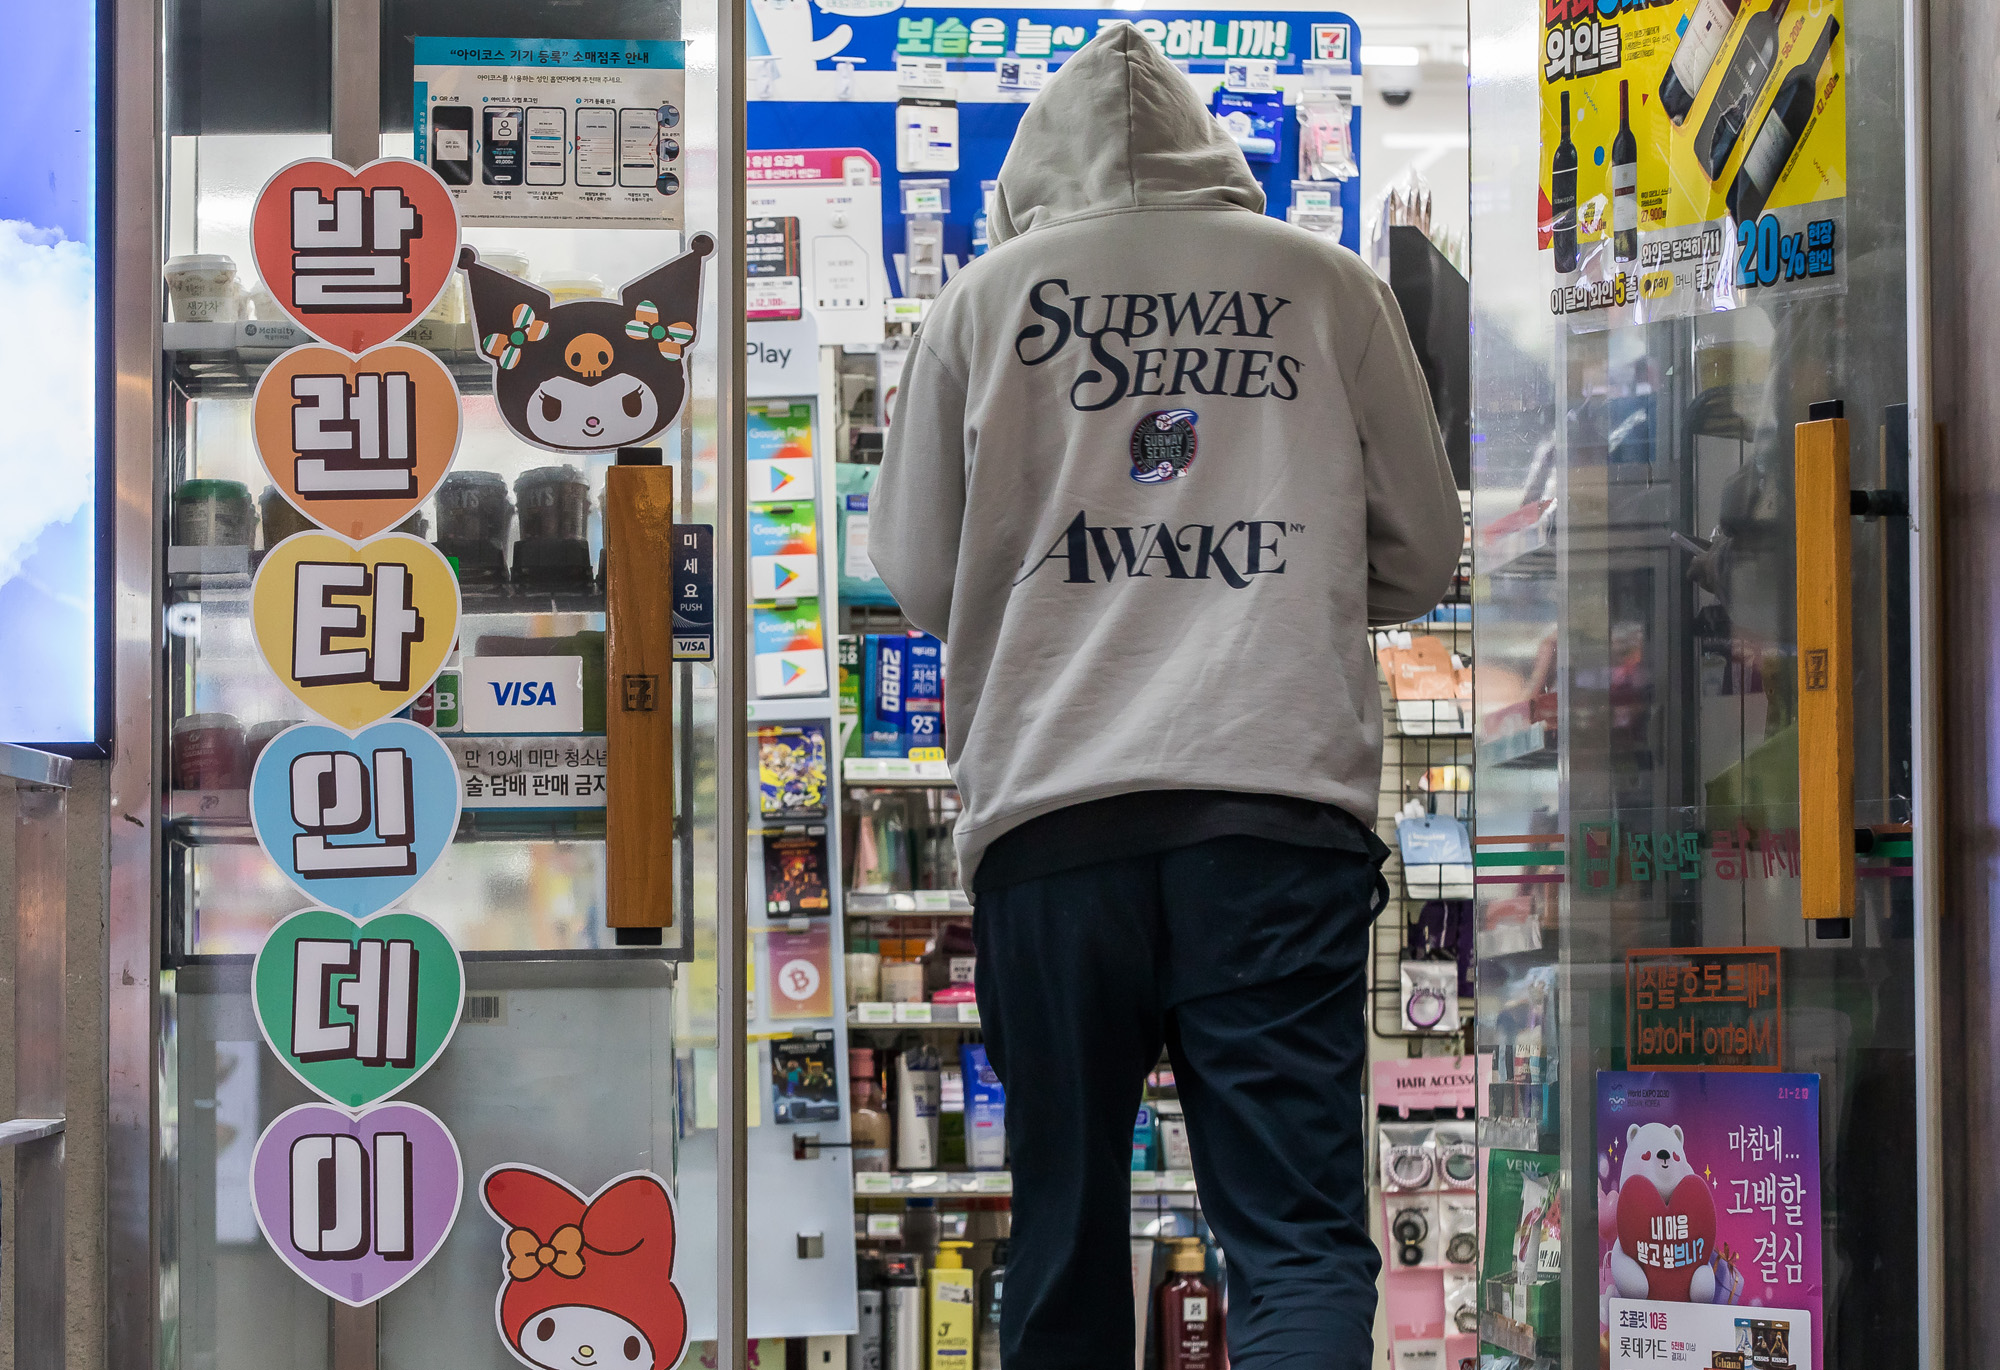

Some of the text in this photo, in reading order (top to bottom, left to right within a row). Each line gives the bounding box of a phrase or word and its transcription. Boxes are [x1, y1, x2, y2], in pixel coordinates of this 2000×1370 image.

[896, 17, 1288, 57] 보습은 늘~ 요하니까!
[450, 49, 649, 65] “아이코스 기기 등록” 소매점주 안내
[1545, 22, 1621, 82] 와인들
[477, 74, 508, 83] 아이코스를
[510, 75, 534, 83] 사용하는
[536, 75, 549, 83] 성인
[1807, 219, 1835, 248] 현장
[1641, 241, 1672, 267] 와인은
[1672, 237, 1702, 262] 당연히
[1737, 214, 1808, 289] 20%
[1808, 248, 1835, 277] 할인
[1550, 272, 1639, 315] 이 달의 와인 5종
[1652, 275, 1669, 294] pay
[1675, 272, 1693, 288] 머니
[187, 301, 219, 316] 생강차
[259, 326, 296, 335] McNulty
[1015, 279, 1291, 366] SUBWAY
[747, 342, 792, 369] Play
[1070, 327, 1305, 411] SERIES
[750, 426, 809, 440] Google Play
[1145, 433, 1184, 447] SUBWAY
[1146, 446, 1182, 459] SERIES
[753, 522, 813, 537] Google Play
[1012, 509, 1287, 589] AWAKE
[683, 533, 699, 598] 미세요
[680, 603, 703, 612] PUSH
[758, 618, 818, 633] Google Play
[678, 641, 706, 652] VISA
[881, 647, 902, 713] 2080
[412, 692, 456, 711] CB
[488, 681, 557, 706] VISA
[911, 715, 934, 735] 93
[465, 749, 480, 768] 만
[488, 749, 522, 768] 19세
[528, 749, 560, 768] 미만
[465, 774, 527, 797] 술·담배
[532, 774, 569, 796] 판매
[1396, 1076, 1427, 1090] HAIR
[1627, 1089, 1670, 1099] World EXPO 2030
[1507, 1158, 1541, 1171] VENY
[1726, 1172, 1807, 1226] 고백할
[1651, 1214, 1689, 1241] 내 마음
[1636, 1240, 1660, 1266] 받고
[1752, 1231, 1803, 1285] 결심
[1619, 1310, 1668, 1331] 초콜릿 10종
[1620, 1336, 1668, 1360] 롯데카드
[1685, 1342, 1697, 1352] 이상
[1714, 1356, 1742, 1370] Ghana
